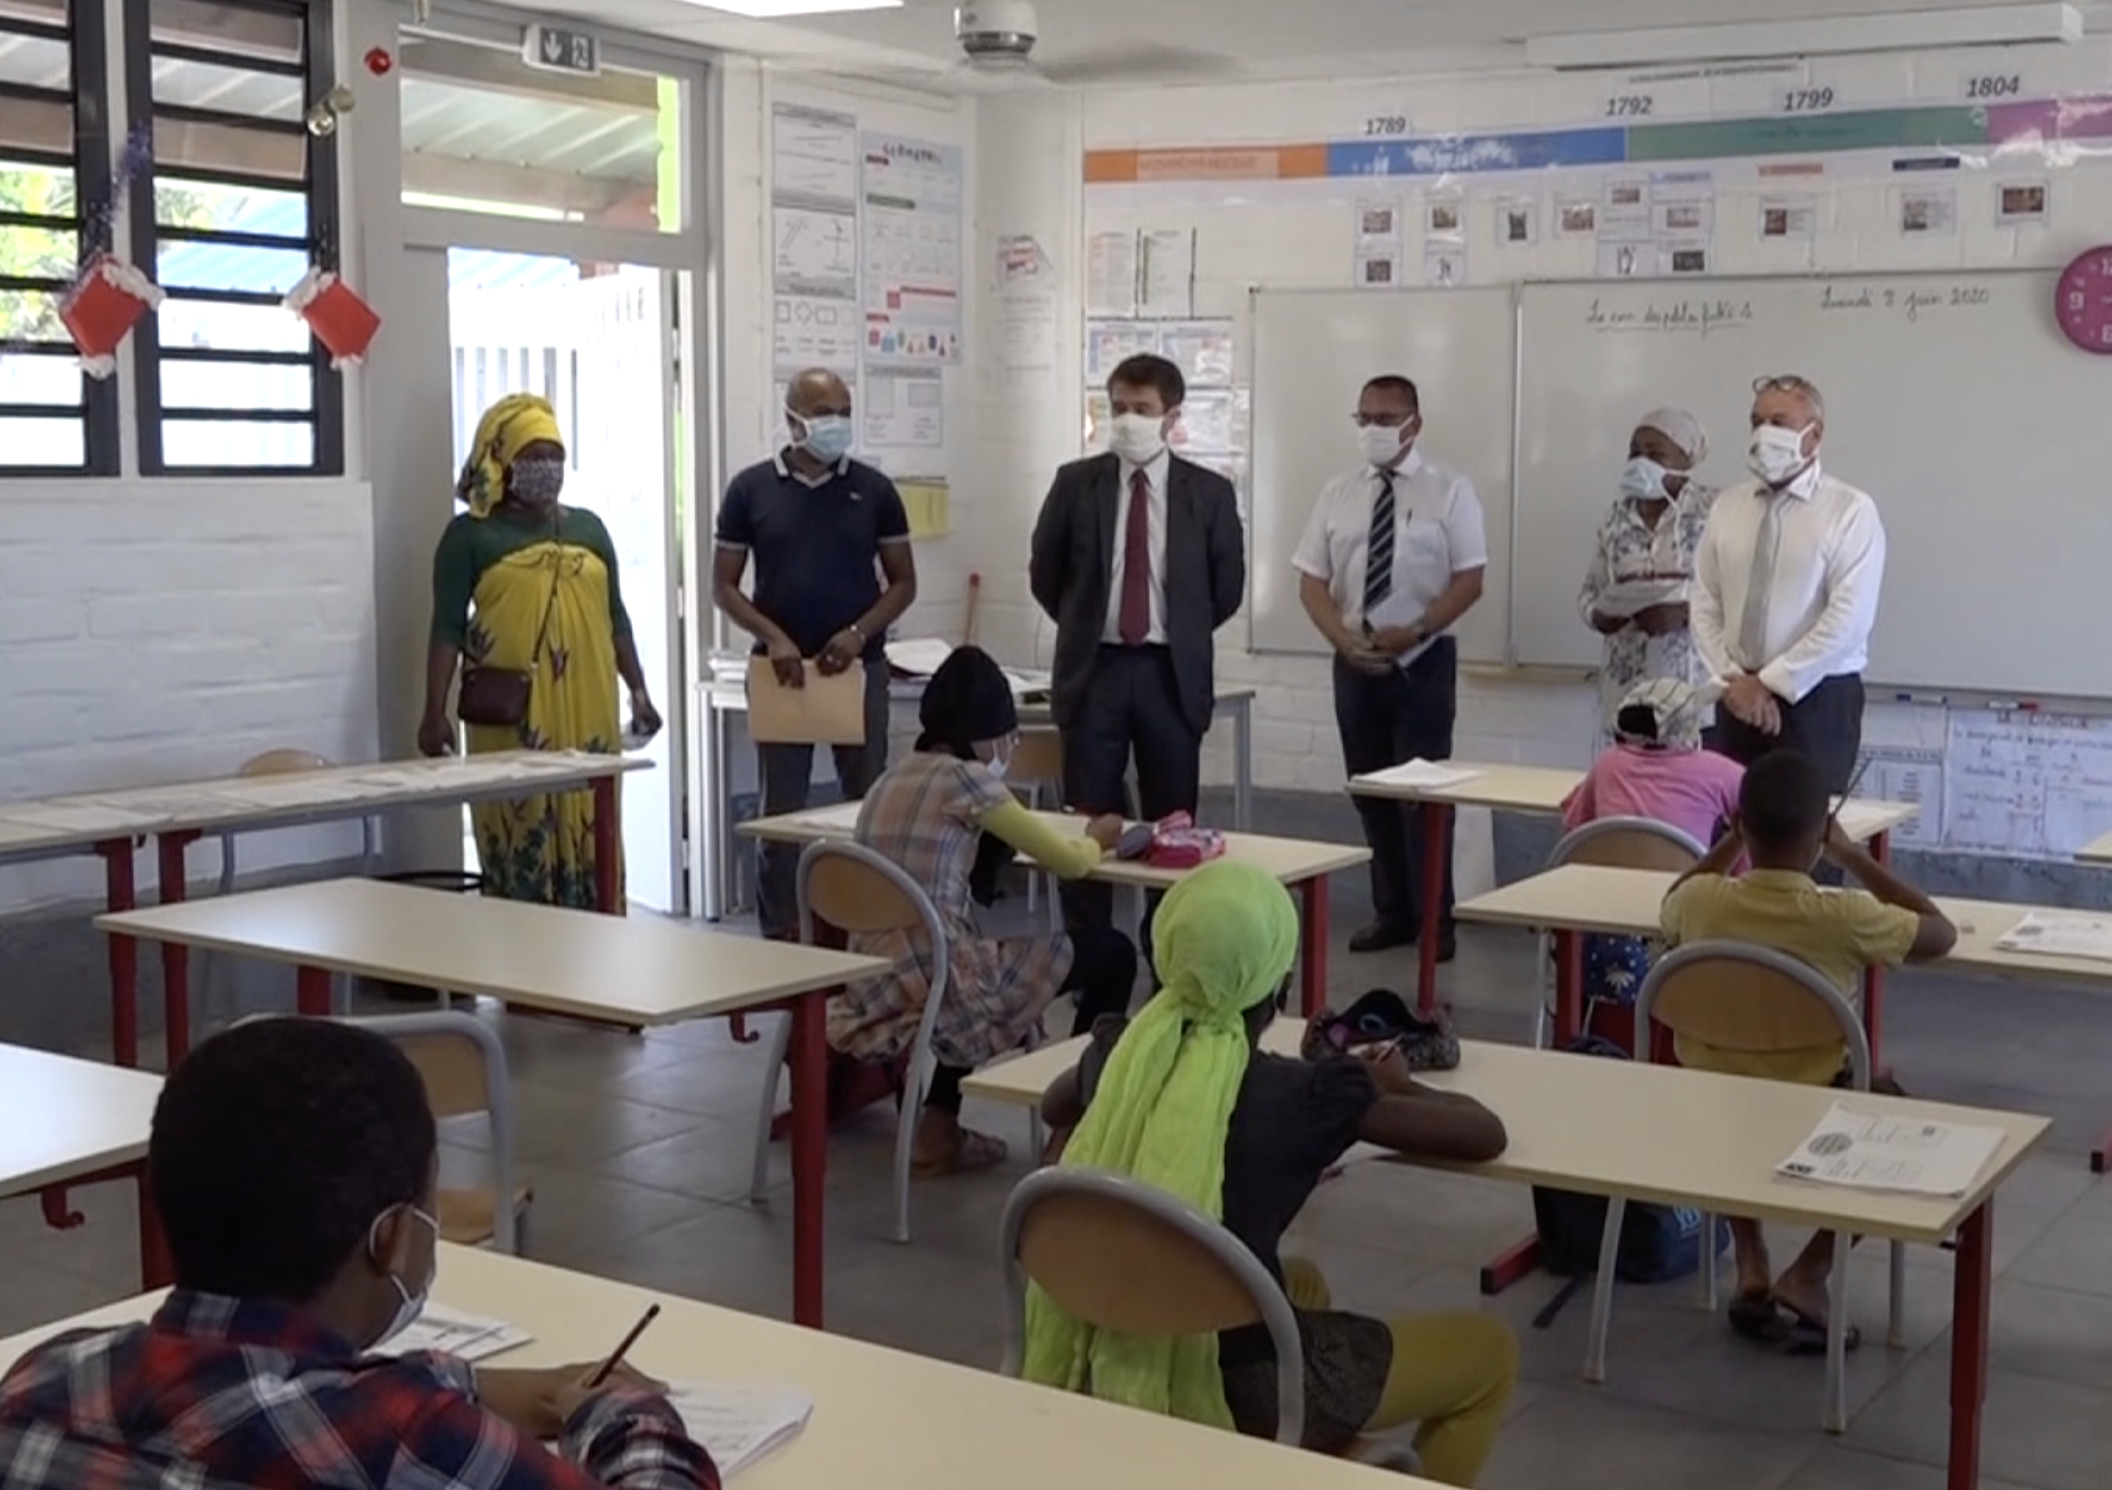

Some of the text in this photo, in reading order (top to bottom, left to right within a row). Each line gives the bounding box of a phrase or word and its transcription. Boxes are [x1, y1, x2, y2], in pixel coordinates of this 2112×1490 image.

[1965, 74, 2020, 98] 1804
[1605, 96, 1653, 116] 1792
[1784, 86, 1834, 111] 1799
[1364, 115, 1406, 136] 1789
[1903, 290, 1941, 323] juin
[1950, 287, 1990, 306] 2020
[2070, 291, 2085, 310] 9
